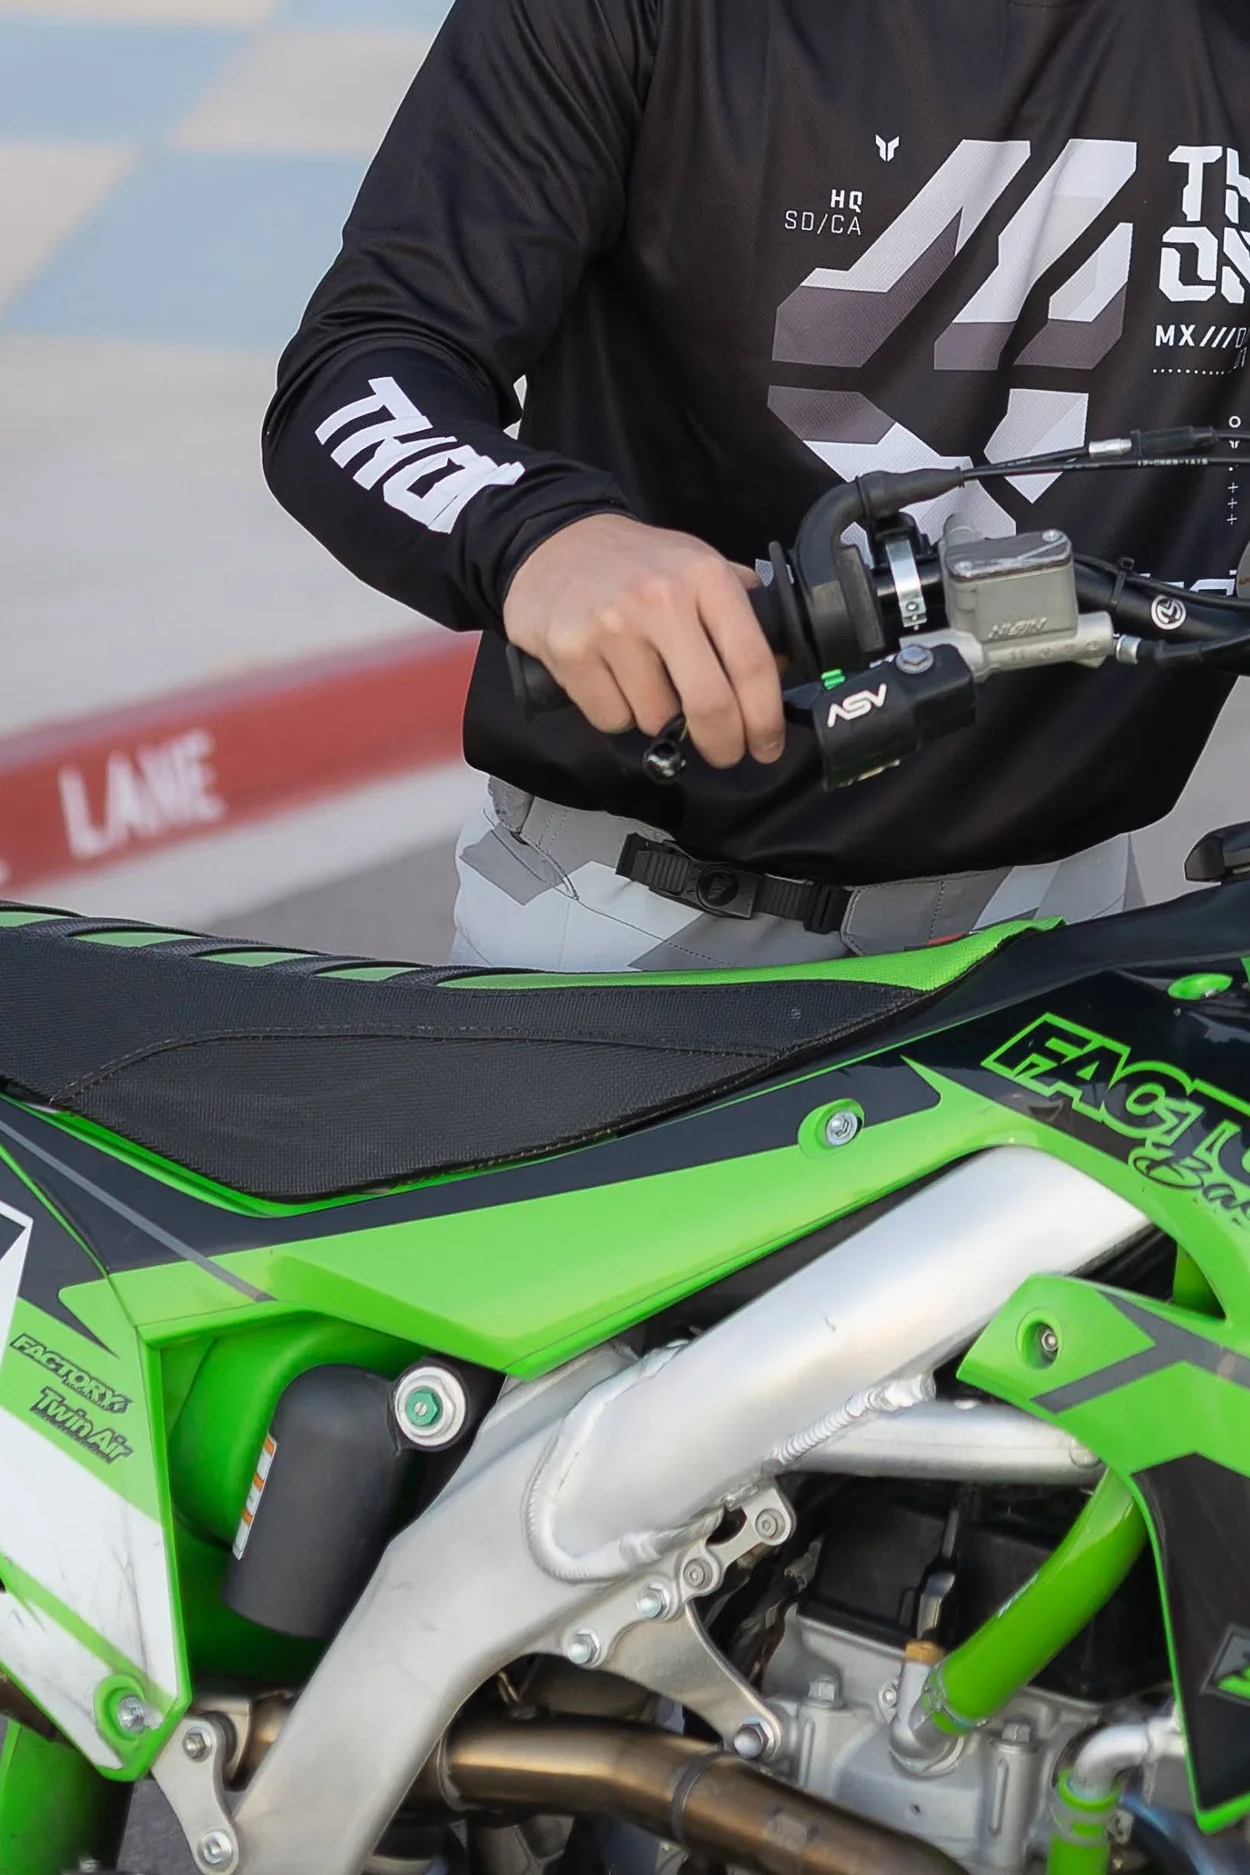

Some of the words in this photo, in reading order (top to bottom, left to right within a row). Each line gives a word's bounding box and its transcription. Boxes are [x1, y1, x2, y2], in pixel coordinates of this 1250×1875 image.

[784, 210, 862, 236] SD/CA
[831, 189, 863, 213] HQ
[827, 683, 887, 728] ASV
[59, 728, 226, 858] LANE
[10, 1333, 130, 1411] FACTORY
